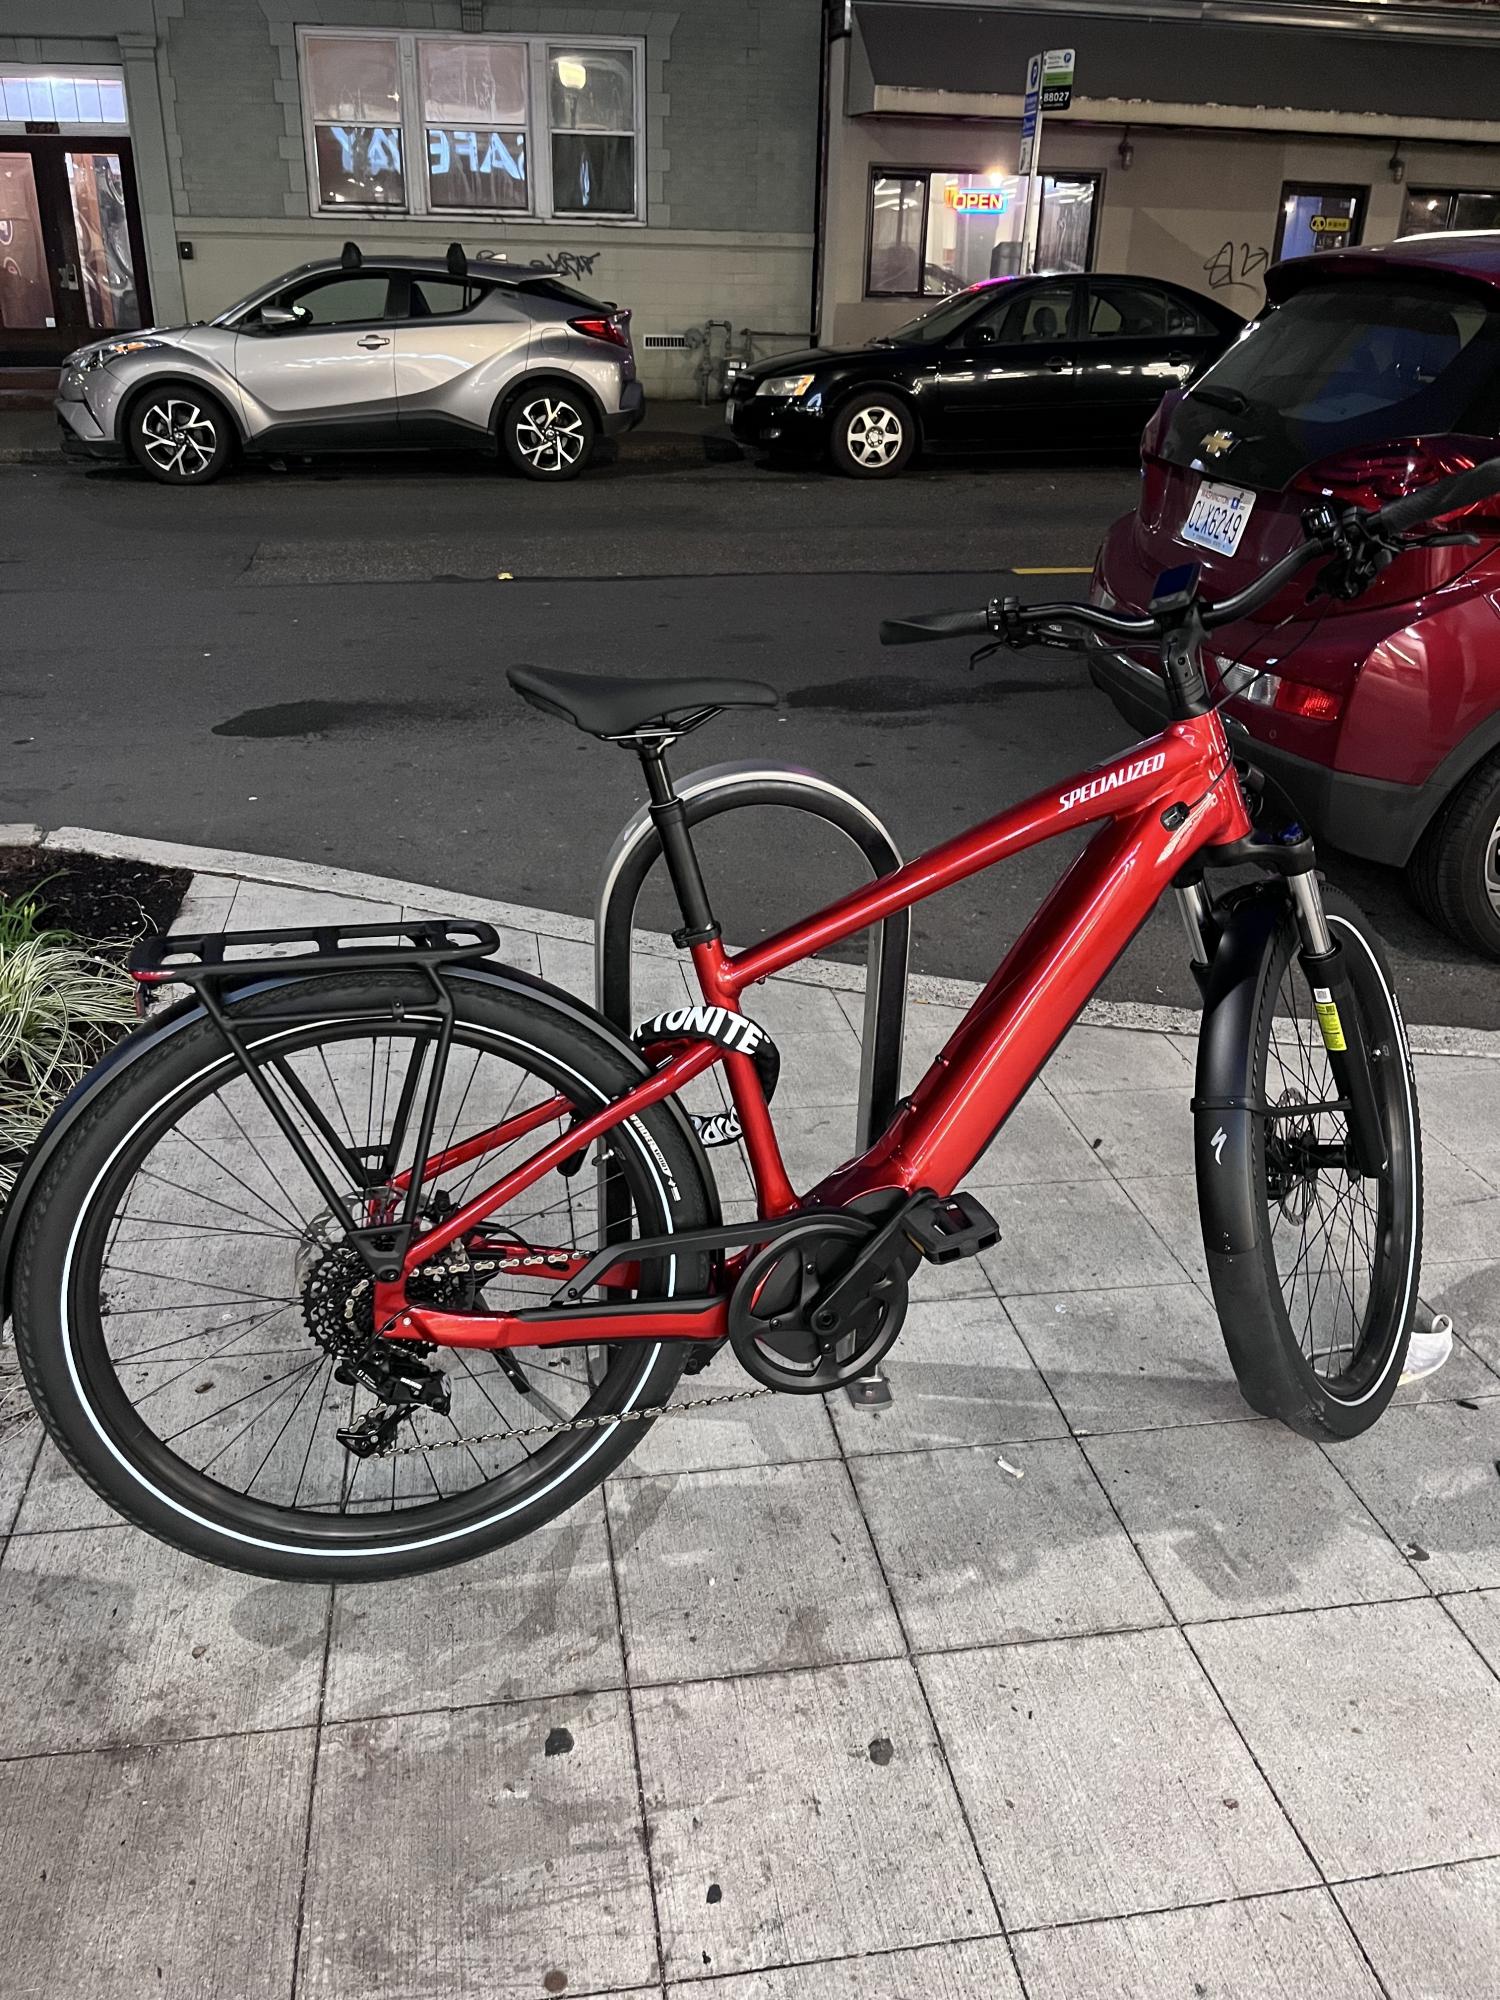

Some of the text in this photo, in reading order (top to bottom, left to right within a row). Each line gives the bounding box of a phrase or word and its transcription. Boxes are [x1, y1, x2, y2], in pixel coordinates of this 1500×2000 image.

[1043, 92, 1069, 102] 88027
[953, 193, 1004, 209] OPEN
[1188, 500, 1242, 544] CLX6249
[1058, 752, 1166, 814] SPECIALIZED
[630, 1006, 764, 1055] TONITE
